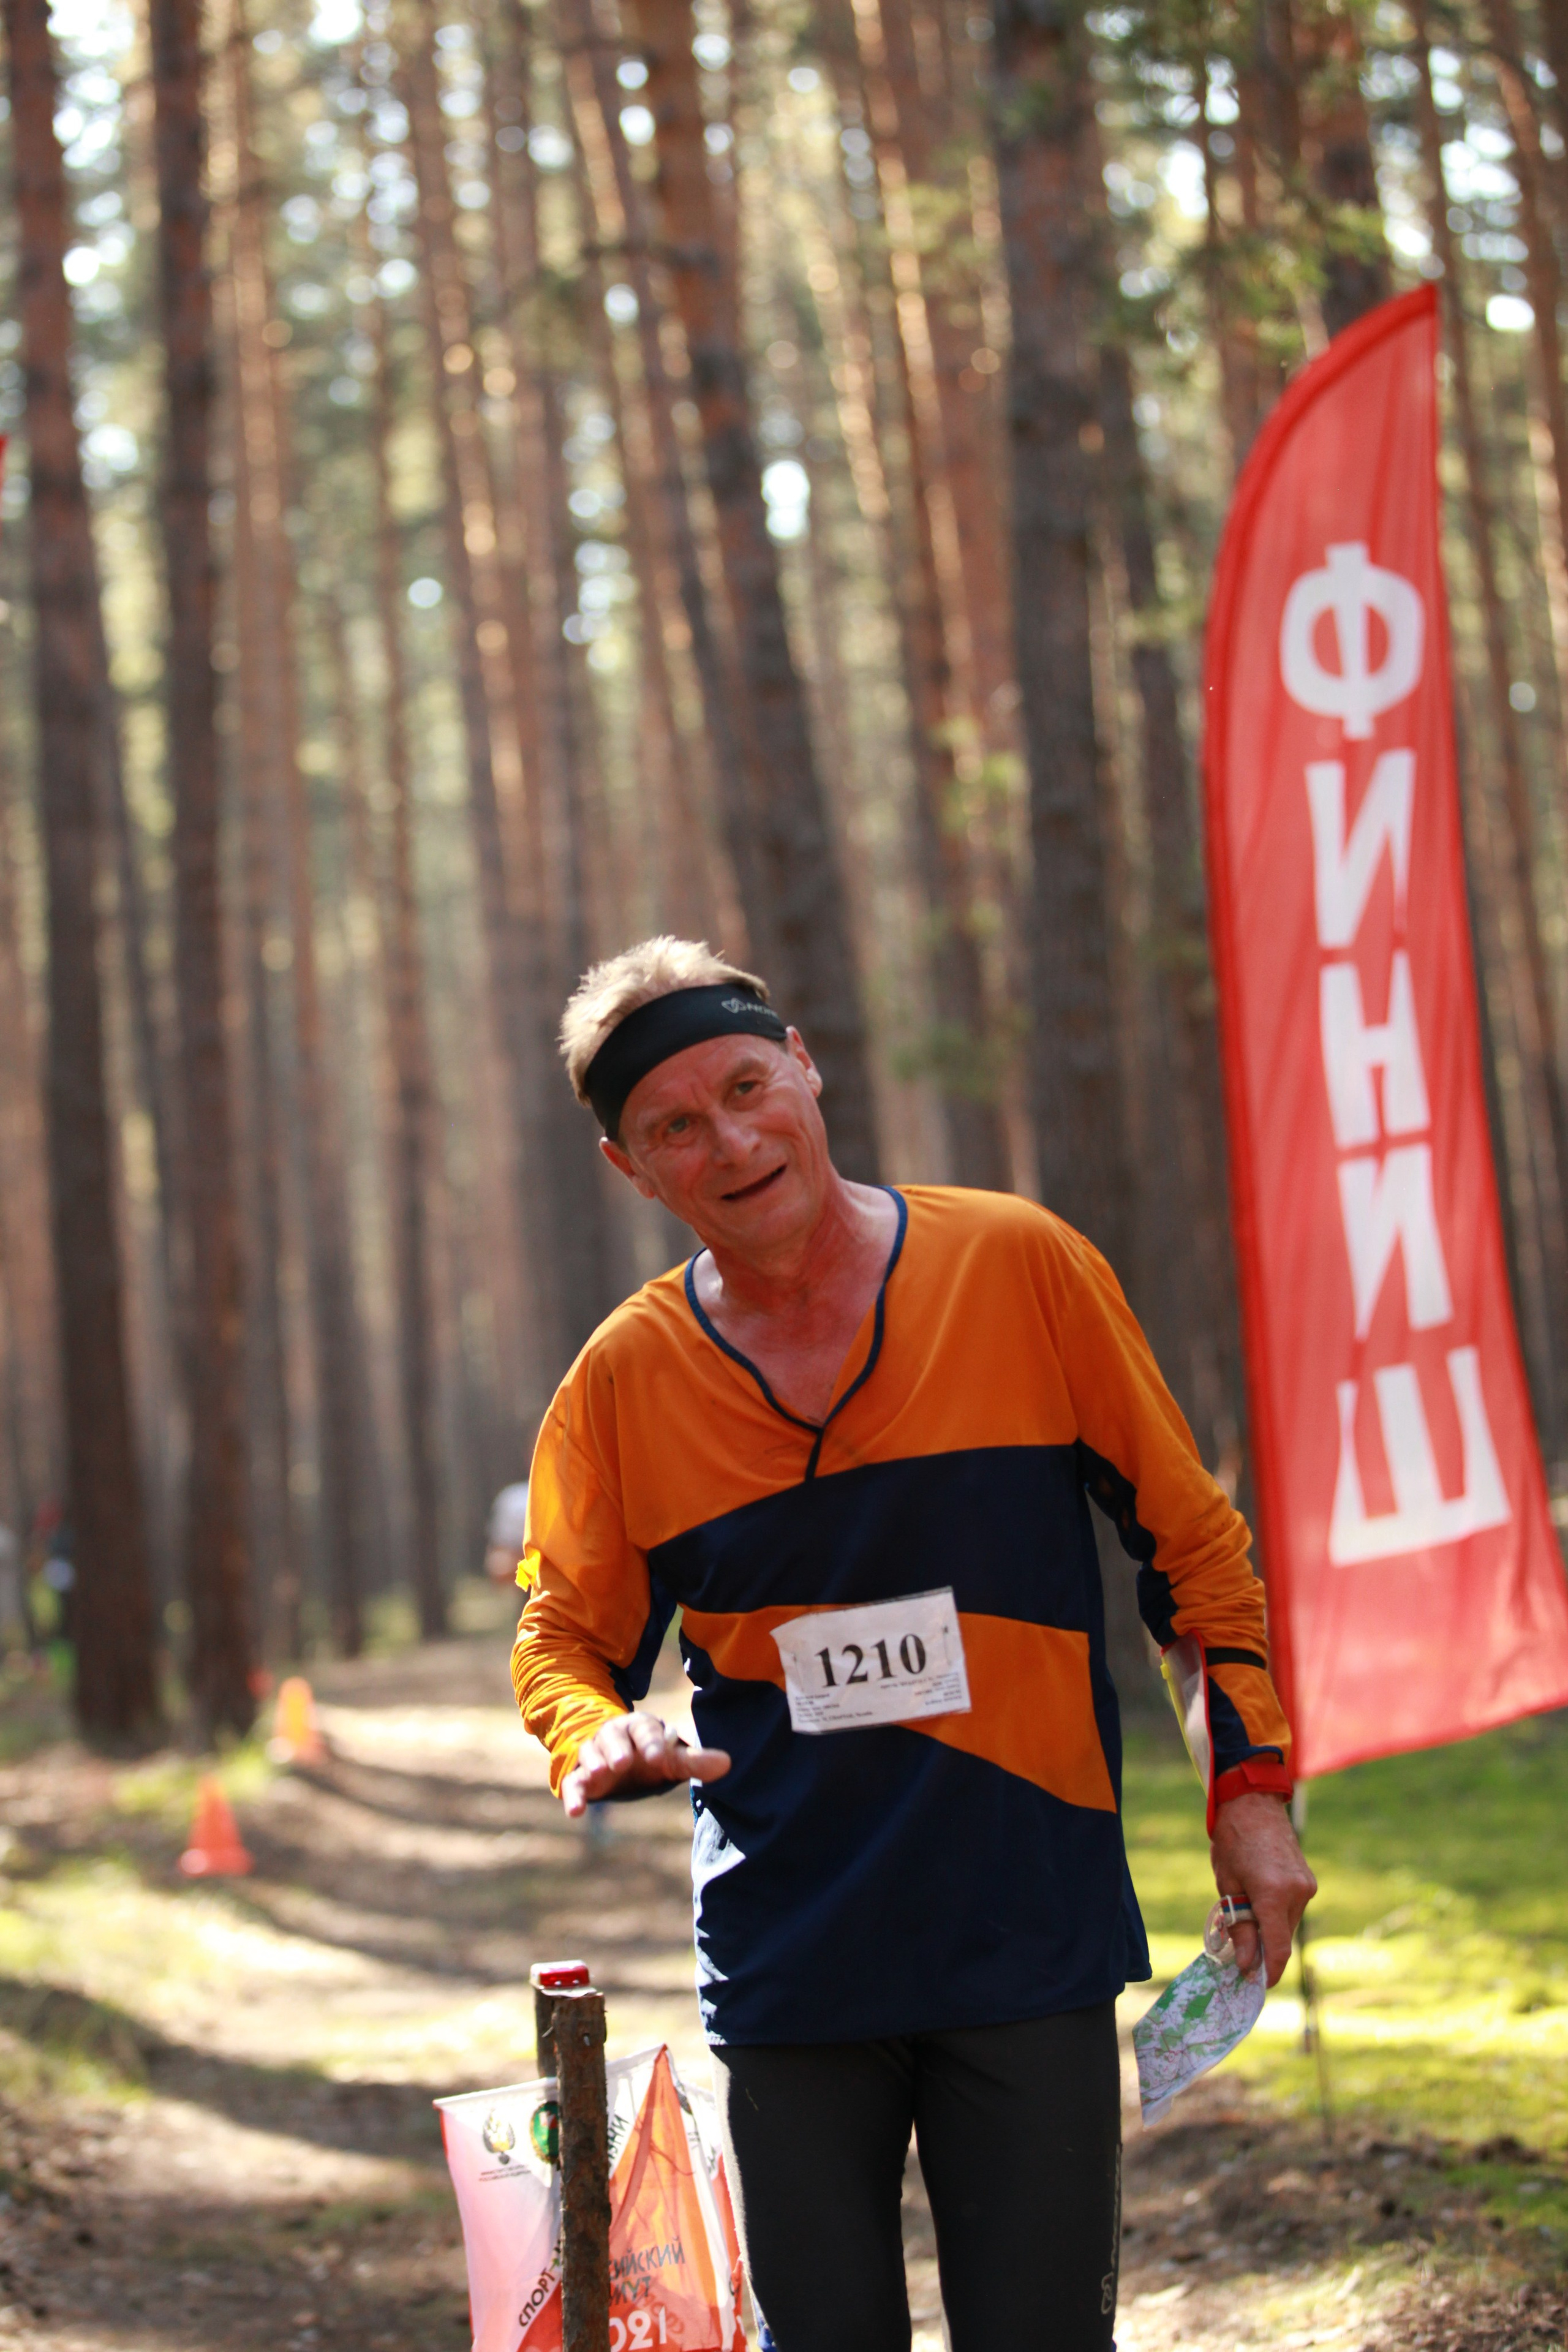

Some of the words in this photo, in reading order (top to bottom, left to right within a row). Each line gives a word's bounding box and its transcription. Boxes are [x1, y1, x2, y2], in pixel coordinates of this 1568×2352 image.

[1279, 541, 1510, 1567] ФИНИШ
[814, 1634, 926, 1688] 1210
[608, 2236, 686, 2281] ИЙСКИЙ
[519, 2267, 556, 2327] СПОРТ
[609, 2275, 651, 2307] МУТ
[609, 2305, 668, 2352] 021
